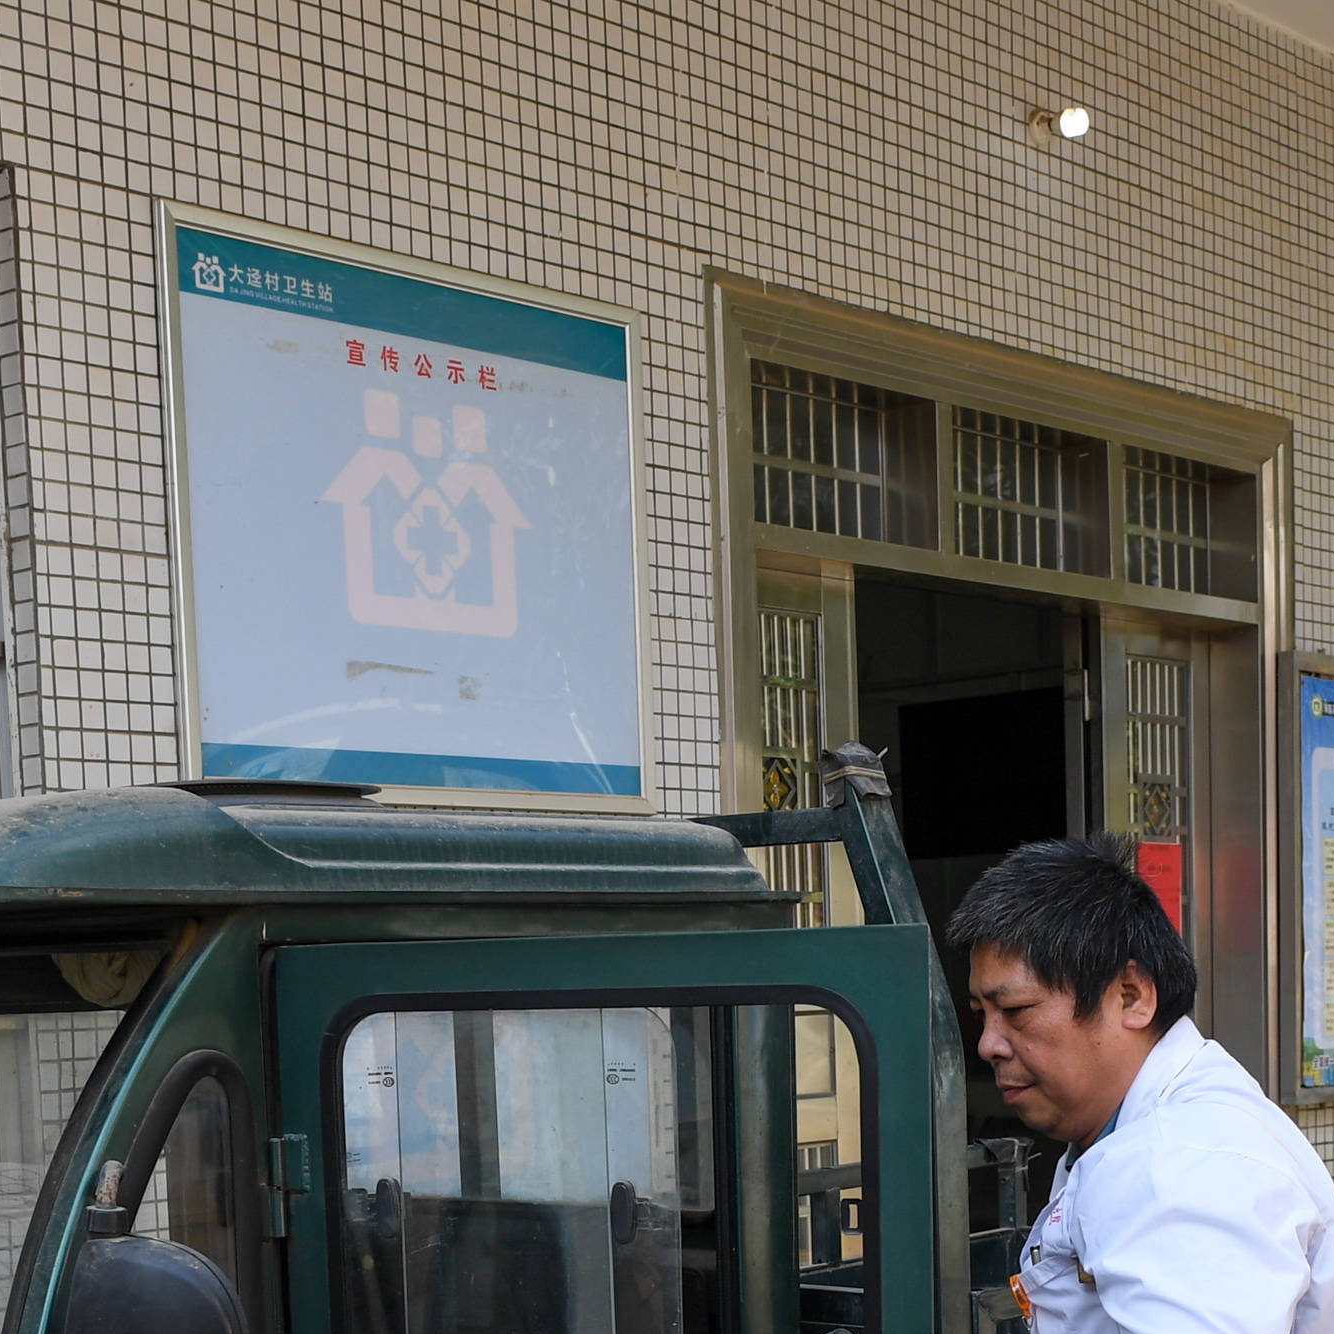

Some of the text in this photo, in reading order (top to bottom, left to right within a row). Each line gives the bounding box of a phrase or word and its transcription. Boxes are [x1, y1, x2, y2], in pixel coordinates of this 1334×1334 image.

[346, 340, 497, 391] 宣传公示栏
